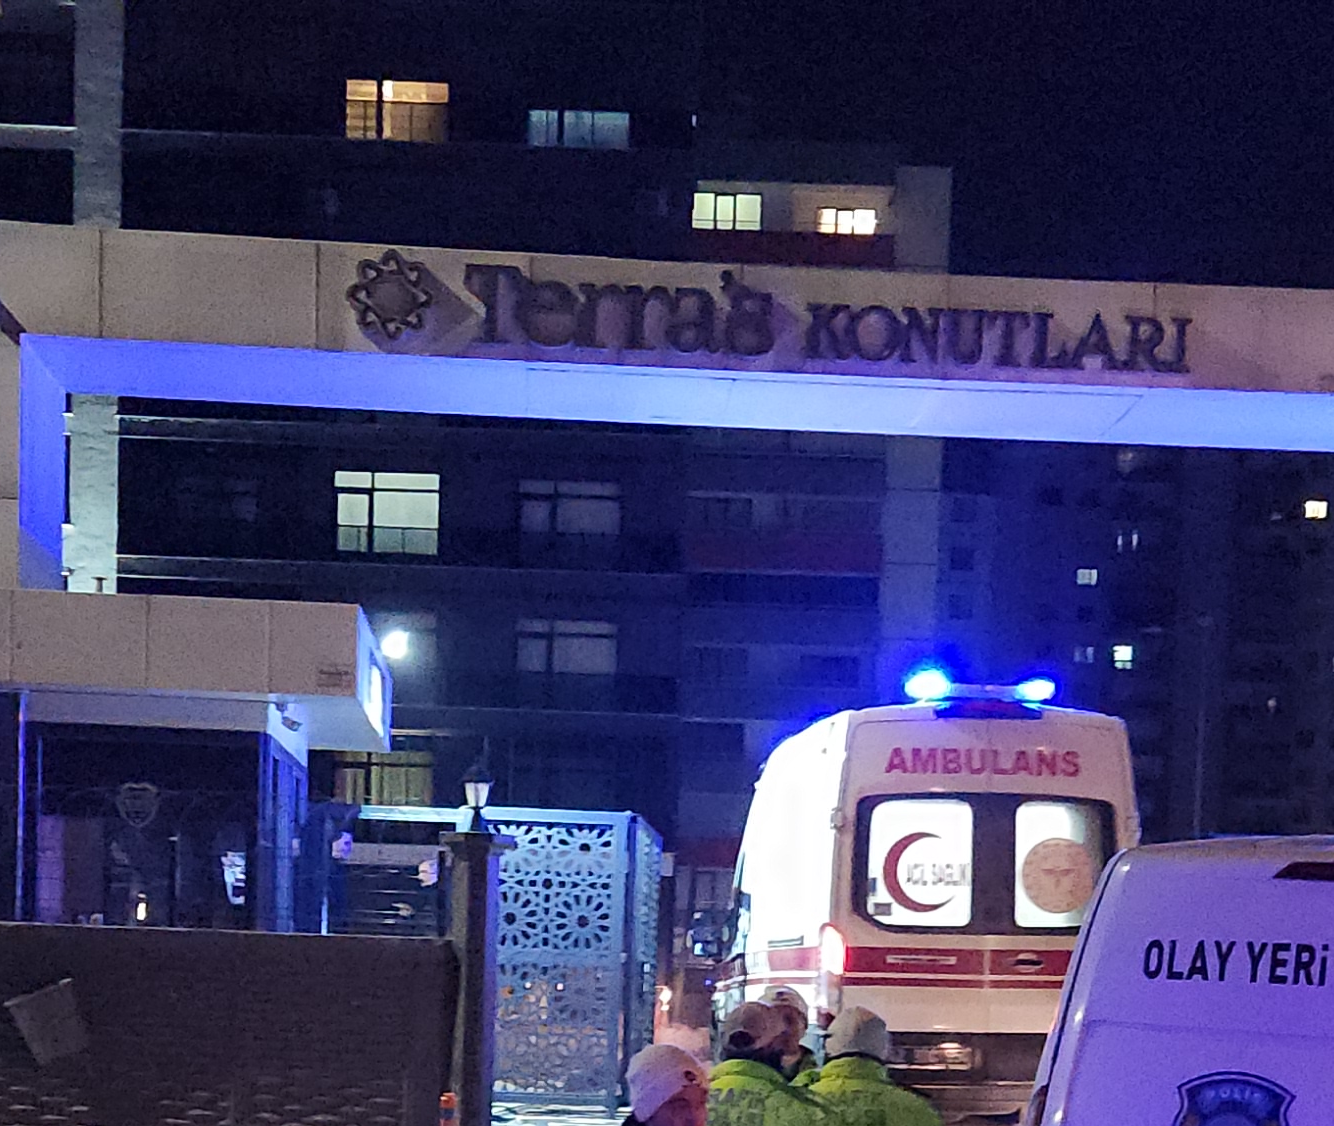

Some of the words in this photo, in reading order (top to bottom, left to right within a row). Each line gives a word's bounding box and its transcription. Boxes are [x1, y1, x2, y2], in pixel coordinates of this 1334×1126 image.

[805, 302, 1194, 373] KONUTLARI
[884, 747, 1080, 777] AMBULANS
[1143, 939, 1237, 982] OLAY
